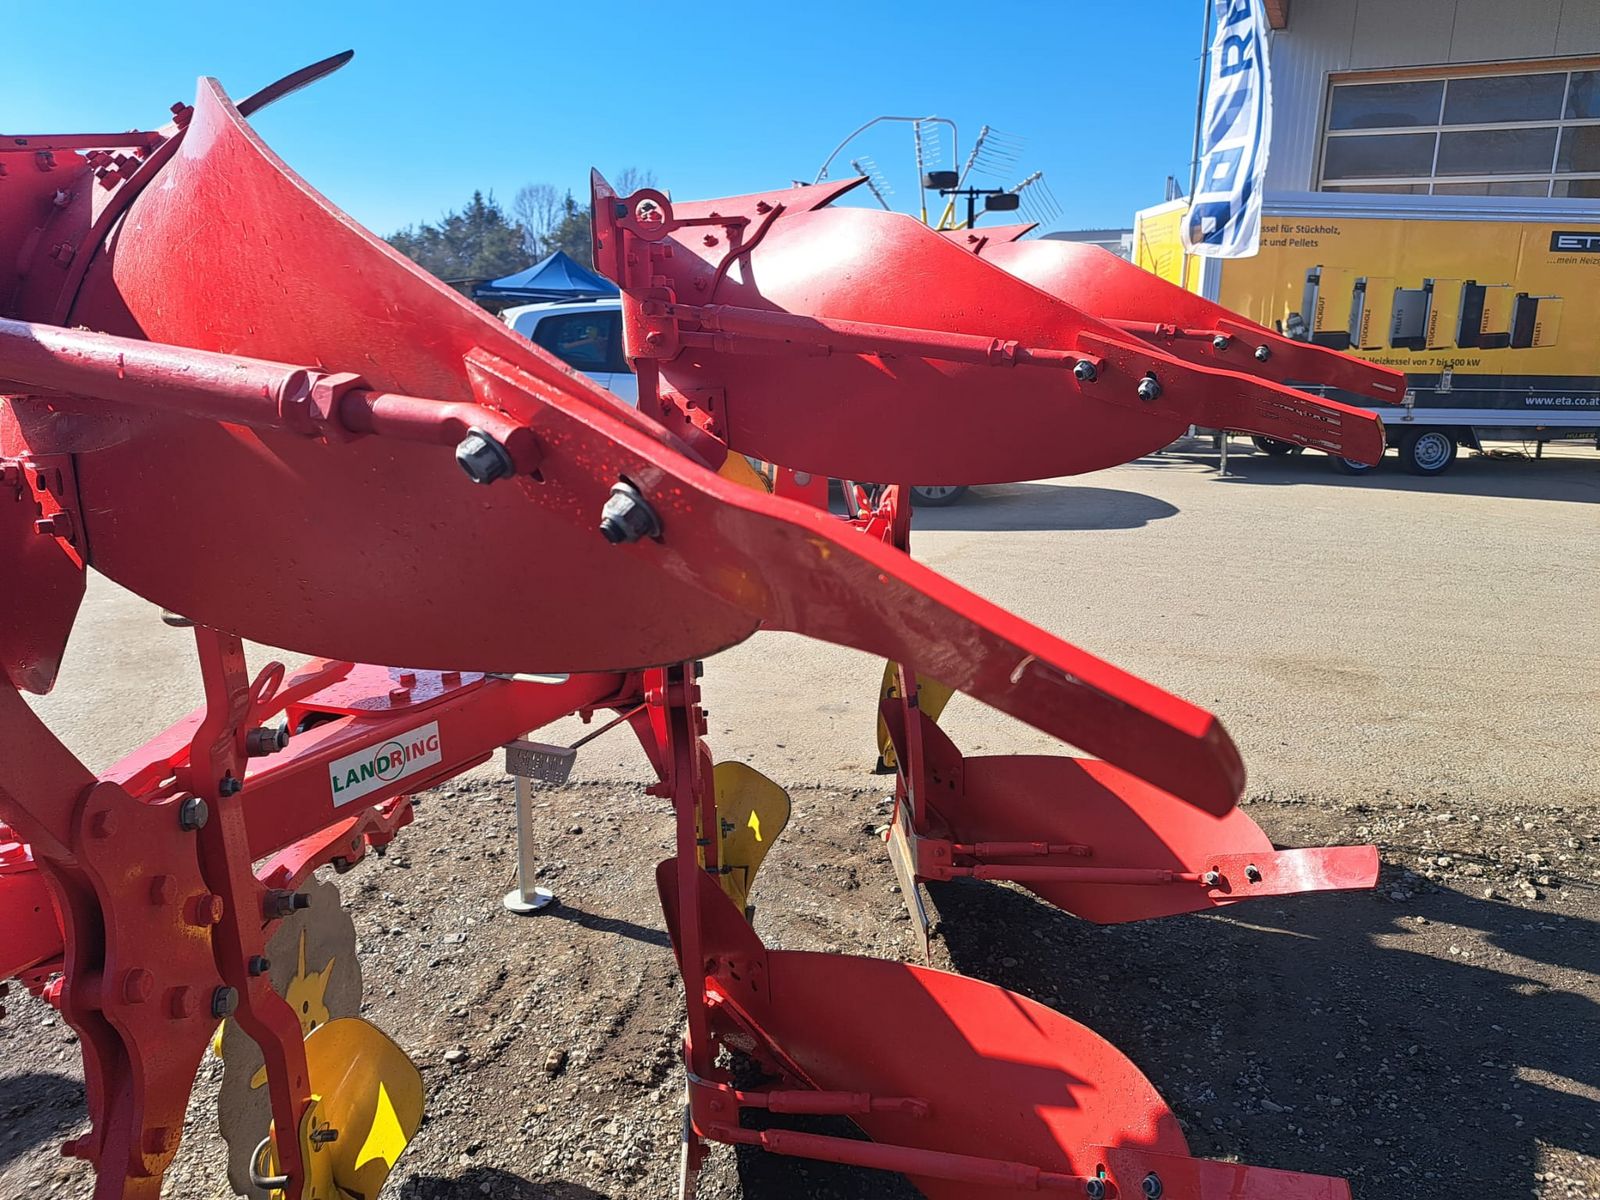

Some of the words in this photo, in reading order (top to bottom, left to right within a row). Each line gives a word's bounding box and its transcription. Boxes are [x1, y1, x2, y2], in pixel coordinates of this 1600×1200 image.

[1281, 224, 1294, 233] für
[1296, 225, 1341, 235] Stückholz,
[1557, 235, 1600, 248] ET
[1270, 239, 1287, 247] und
[1289, 239, 1319, 247] Pellets
[1579, 256, 1600, 265] Heiz
[1316, 296, 1326, 330] HACKGUT
[1394, 309, 1404, 335] PELLETS
[1482, 308, 1490, 332] PELLETS
[1361, 308, 1371, 346] STÜCKHOLZ
[1428, 309, 1438, 346] STÜCKHOLZ
[1533, 322, 1542, 346] PELLETS
[1467, 358, 1481, 367] kW
[1525, 396, 1600, 406] www.eta.co.at
[332, 734, 440, 794] LANDRING
